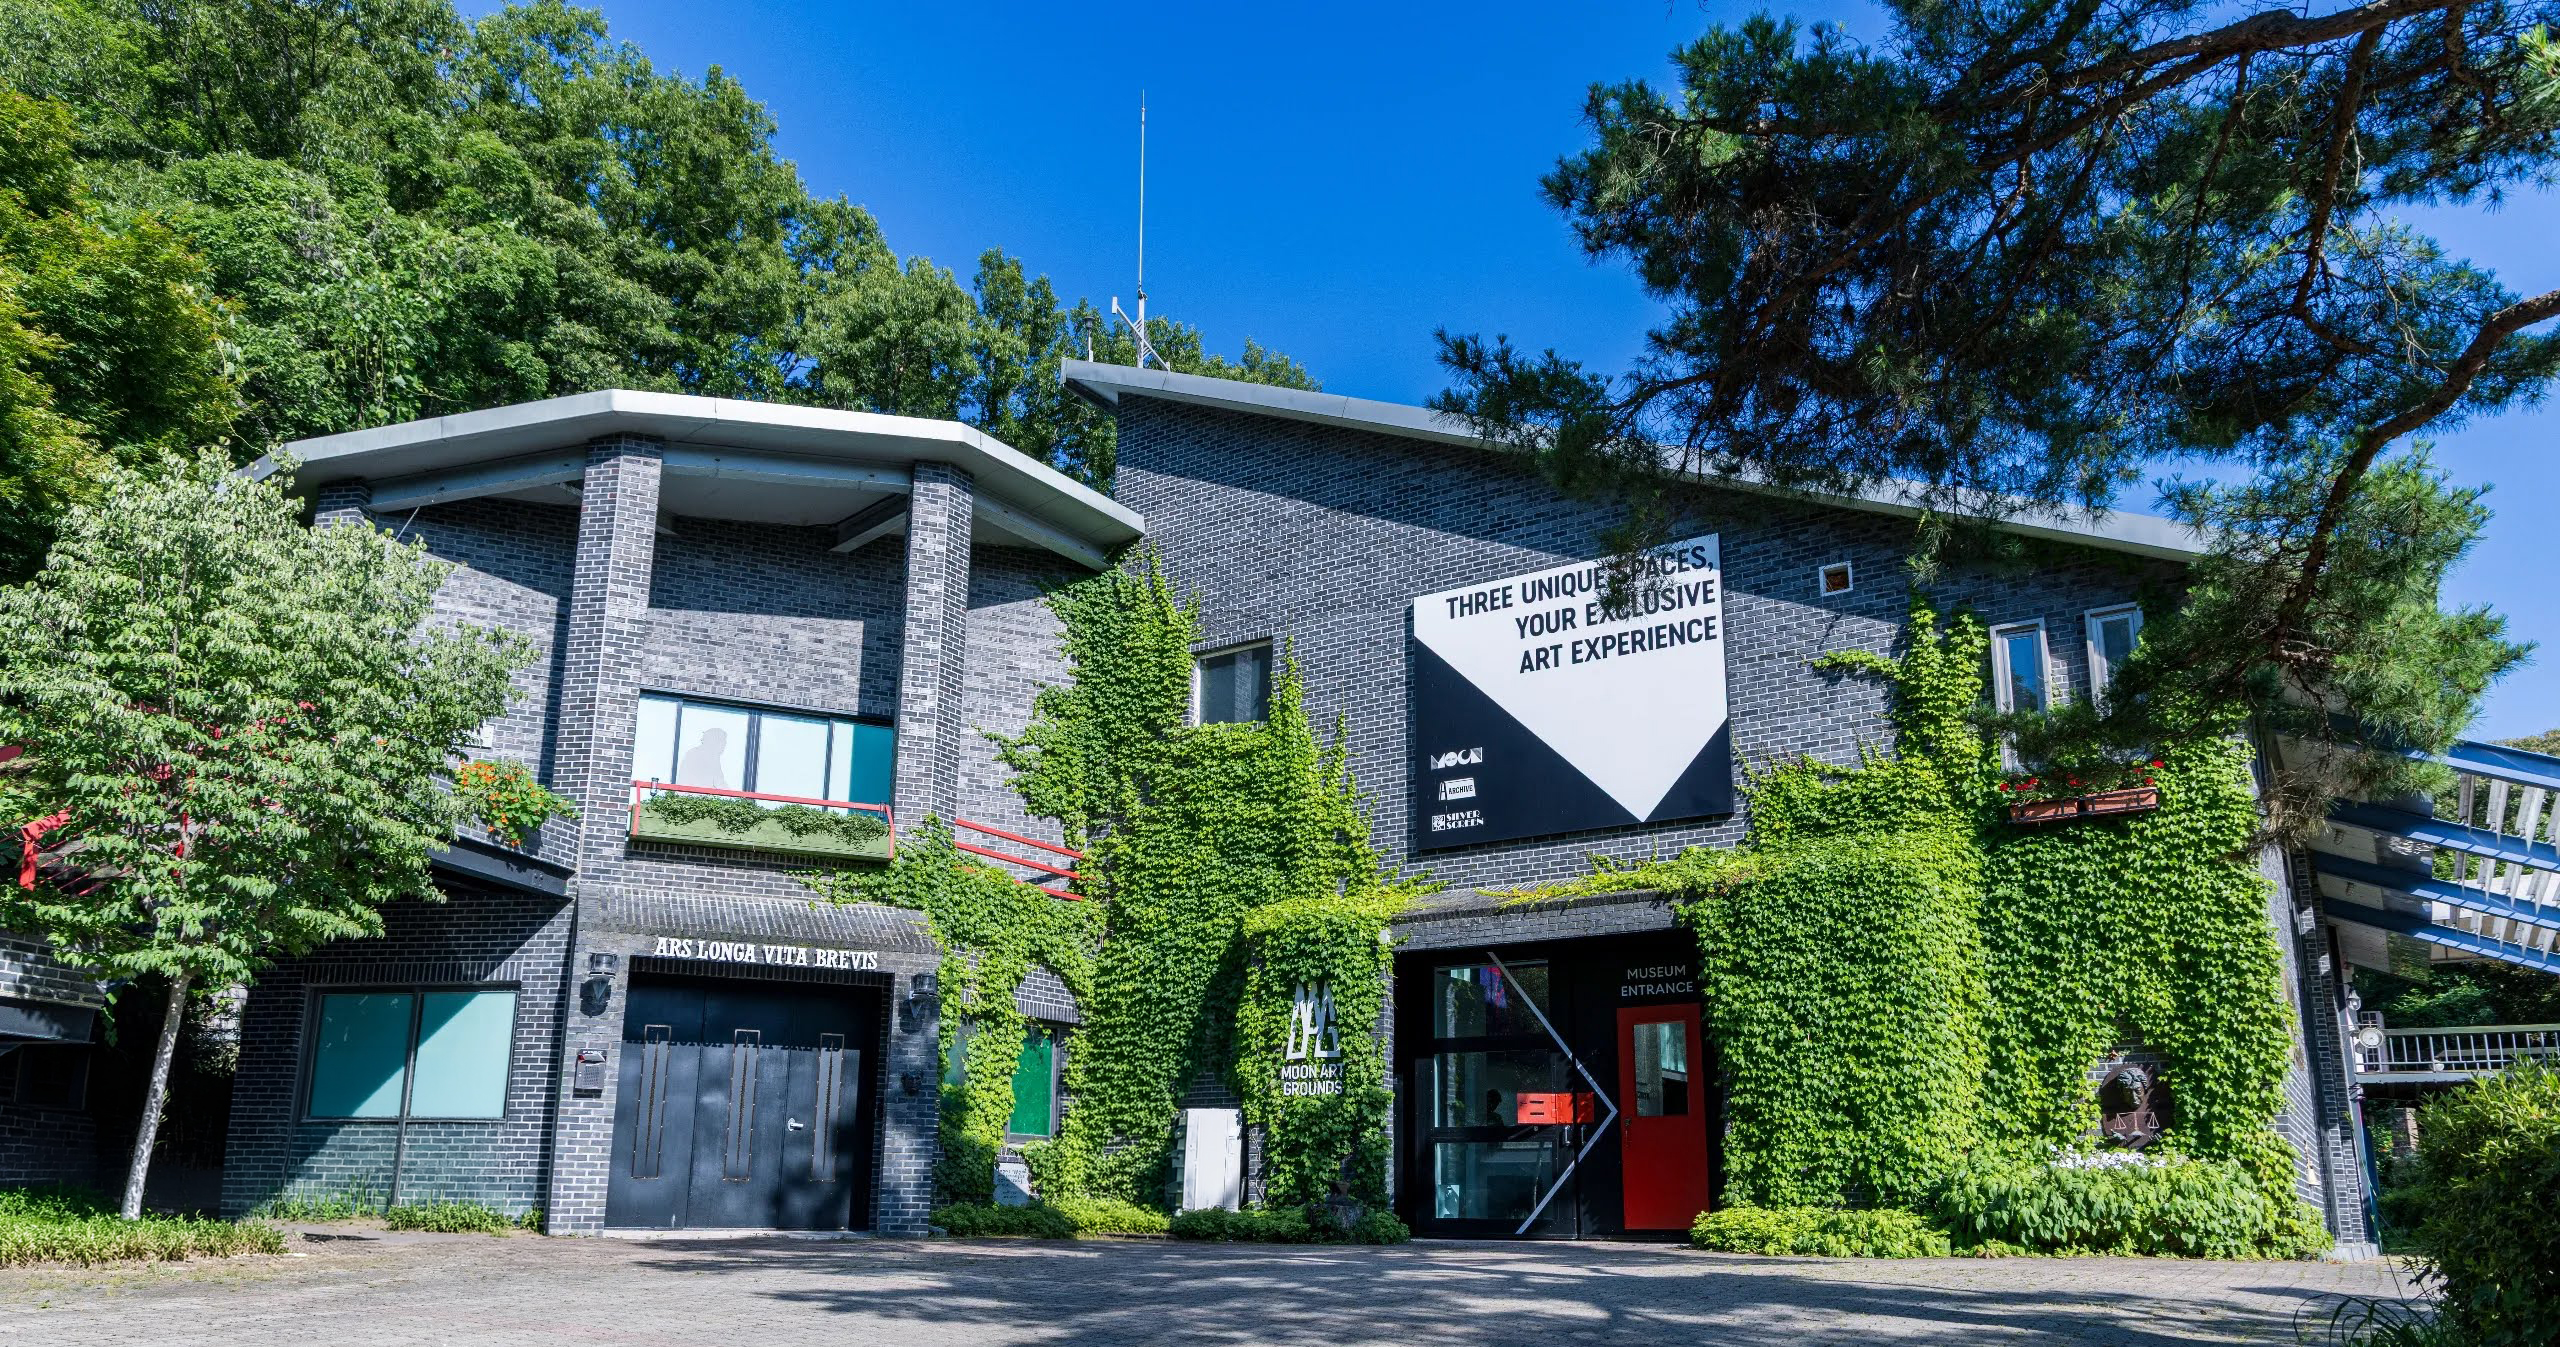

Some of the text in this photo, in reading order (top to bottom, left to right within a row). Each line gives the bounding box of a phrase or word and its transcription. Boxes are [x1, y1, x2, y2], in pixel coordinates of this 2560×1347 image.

[1446, 545, 1713, 619] THREE UNIQUE PACES,
[1515, 607, 1577, 639] YOUR
[1520, 616, 1717, 674] ART EXPERIENCE
[1448, 784, 1474, 795] ARCHIVE
[1446, 809, 1481, 822] SILVER
[1446, 817, 1484, 830] SCREEN
[654, 936, 878, 970] ARS LONGA VITA BREVIS
[1627, 965, 1686, 980] MUSEUM
[1621, 981, 1694, 997] ENTRANCE
[1281, 1062, 1345, 1080] MOON ART
[1283, 1080, 1344, 1097] GROUNDS
